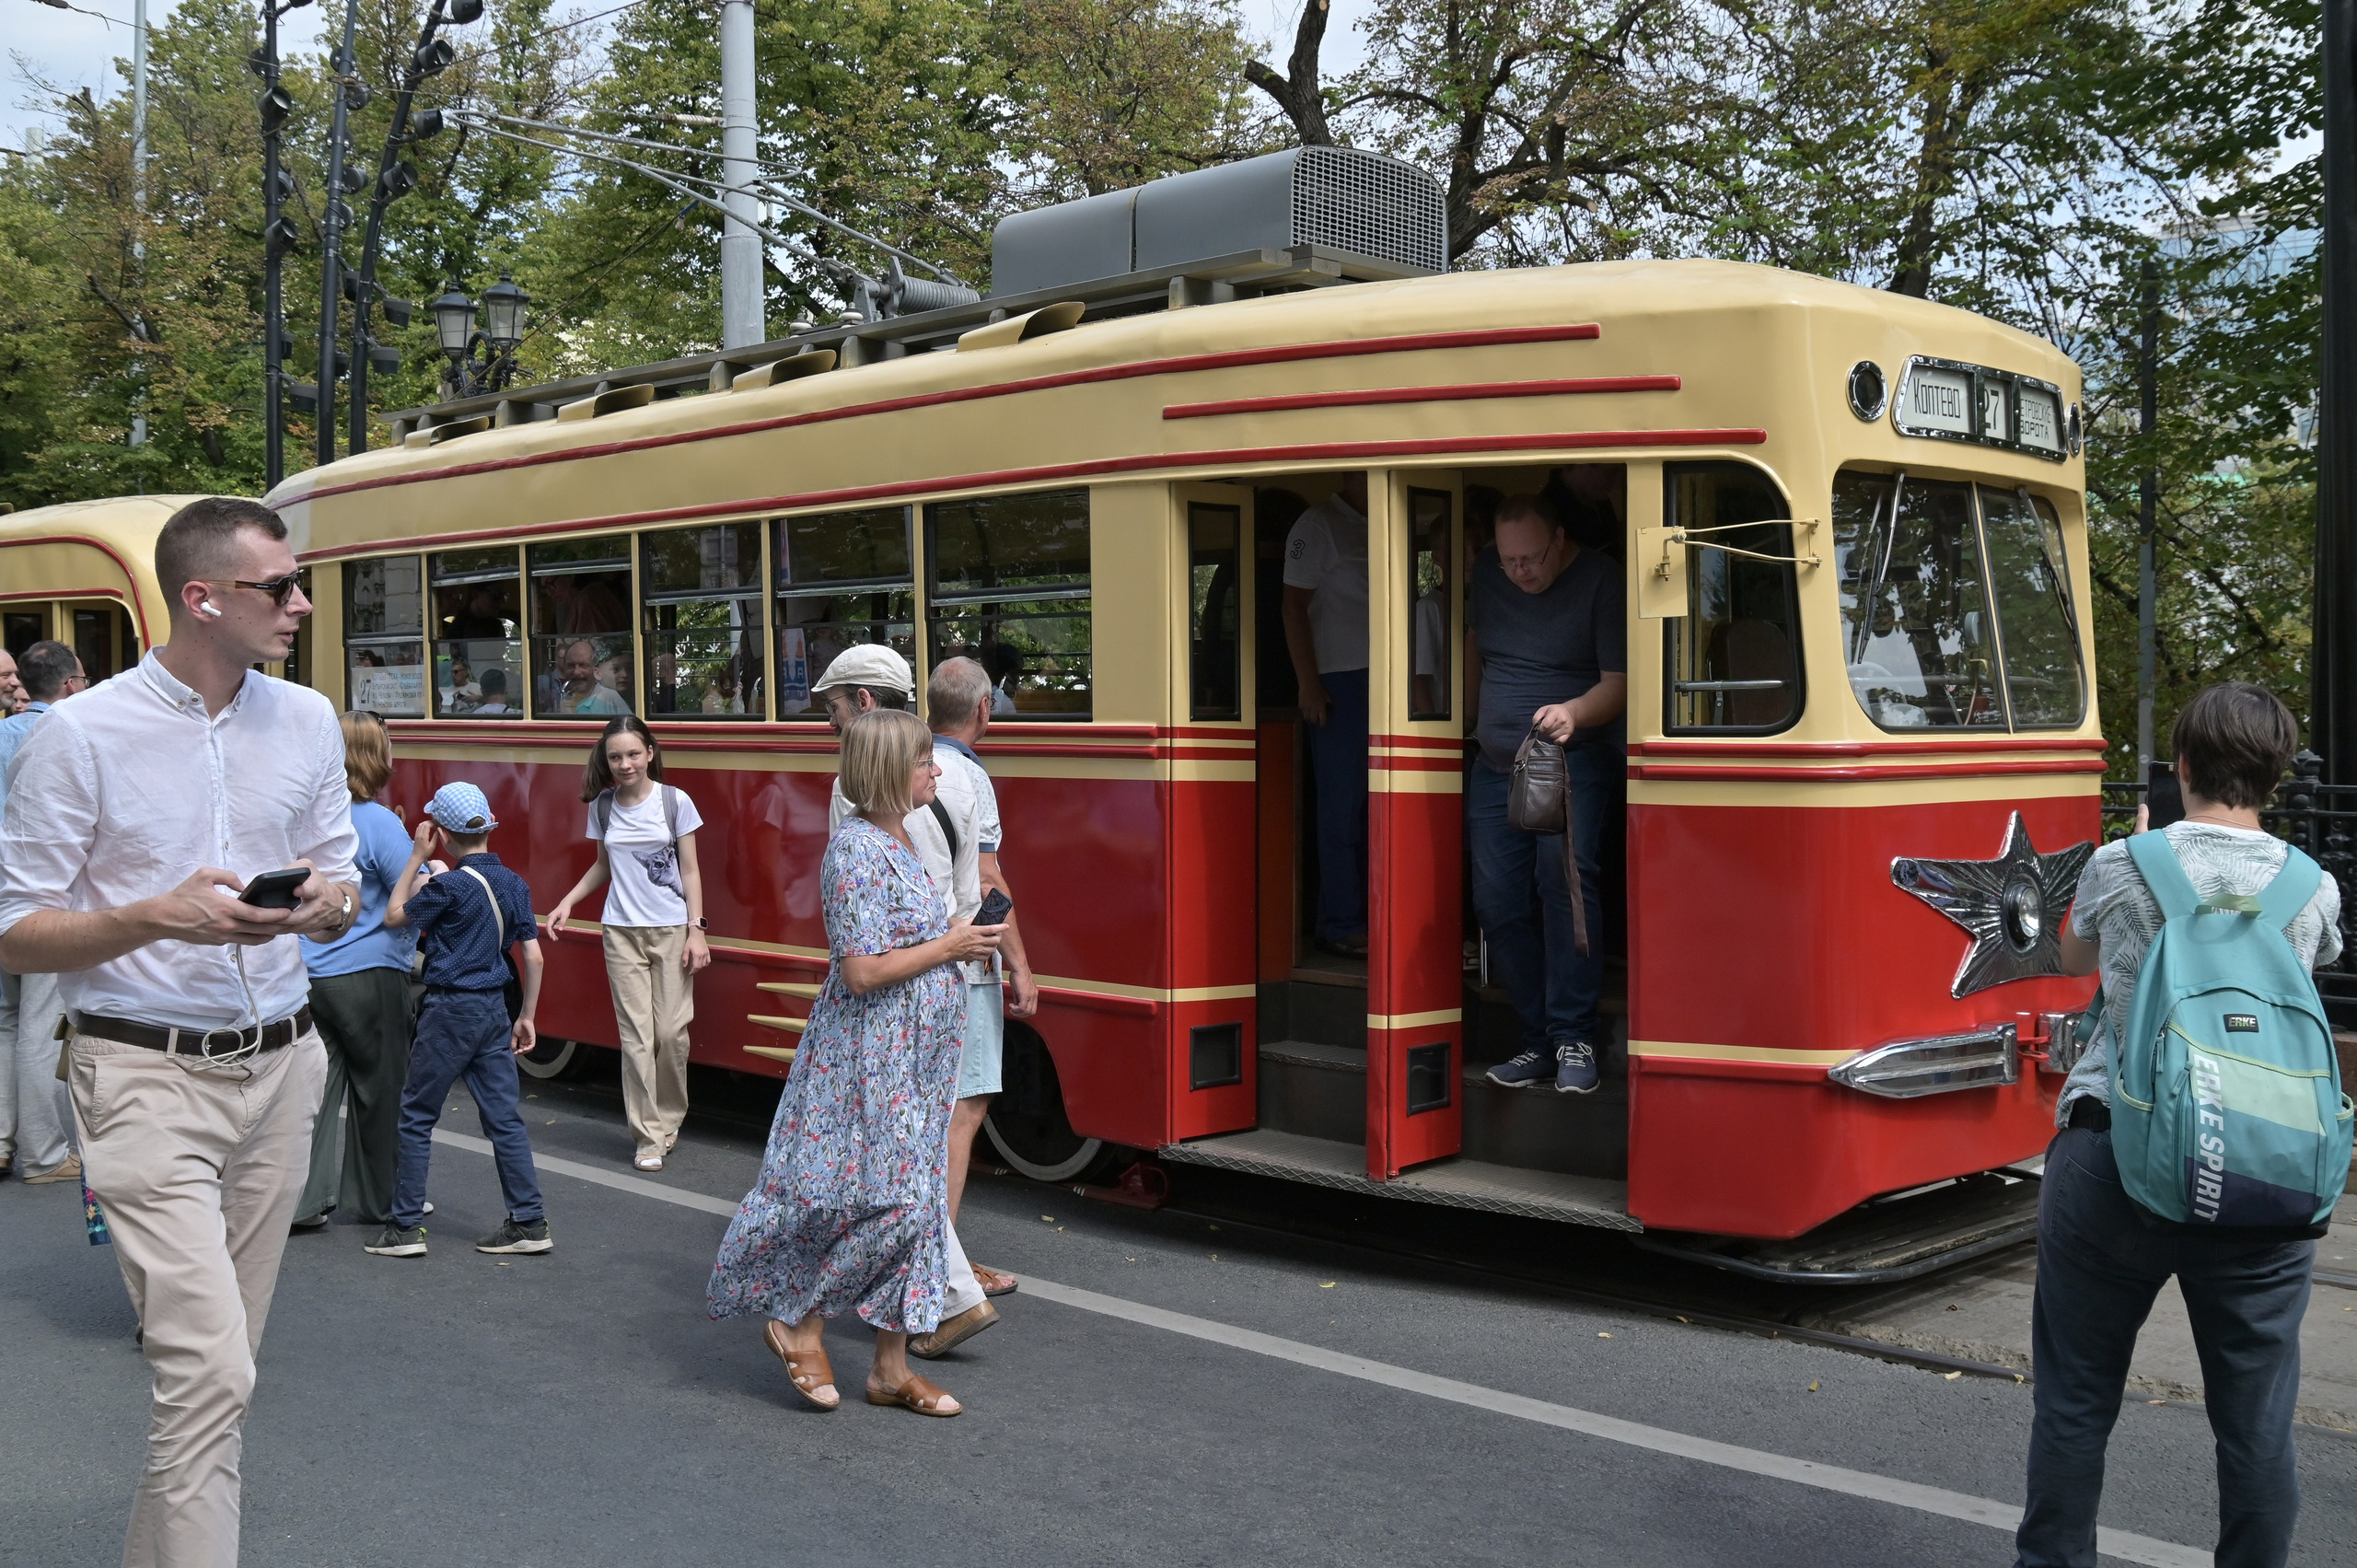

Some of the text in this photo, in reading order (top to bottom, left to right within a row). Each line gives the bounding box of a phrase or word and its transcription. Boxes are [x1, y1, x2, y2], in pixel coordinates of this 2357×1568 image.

[1289, 539, 1306, 560] 3
[360, 679, 372, 703] 27
[2228, 1016, 2257, 1028] ERKE
[2193, 1053, 2225, 1223] ERKE SPIRIT
